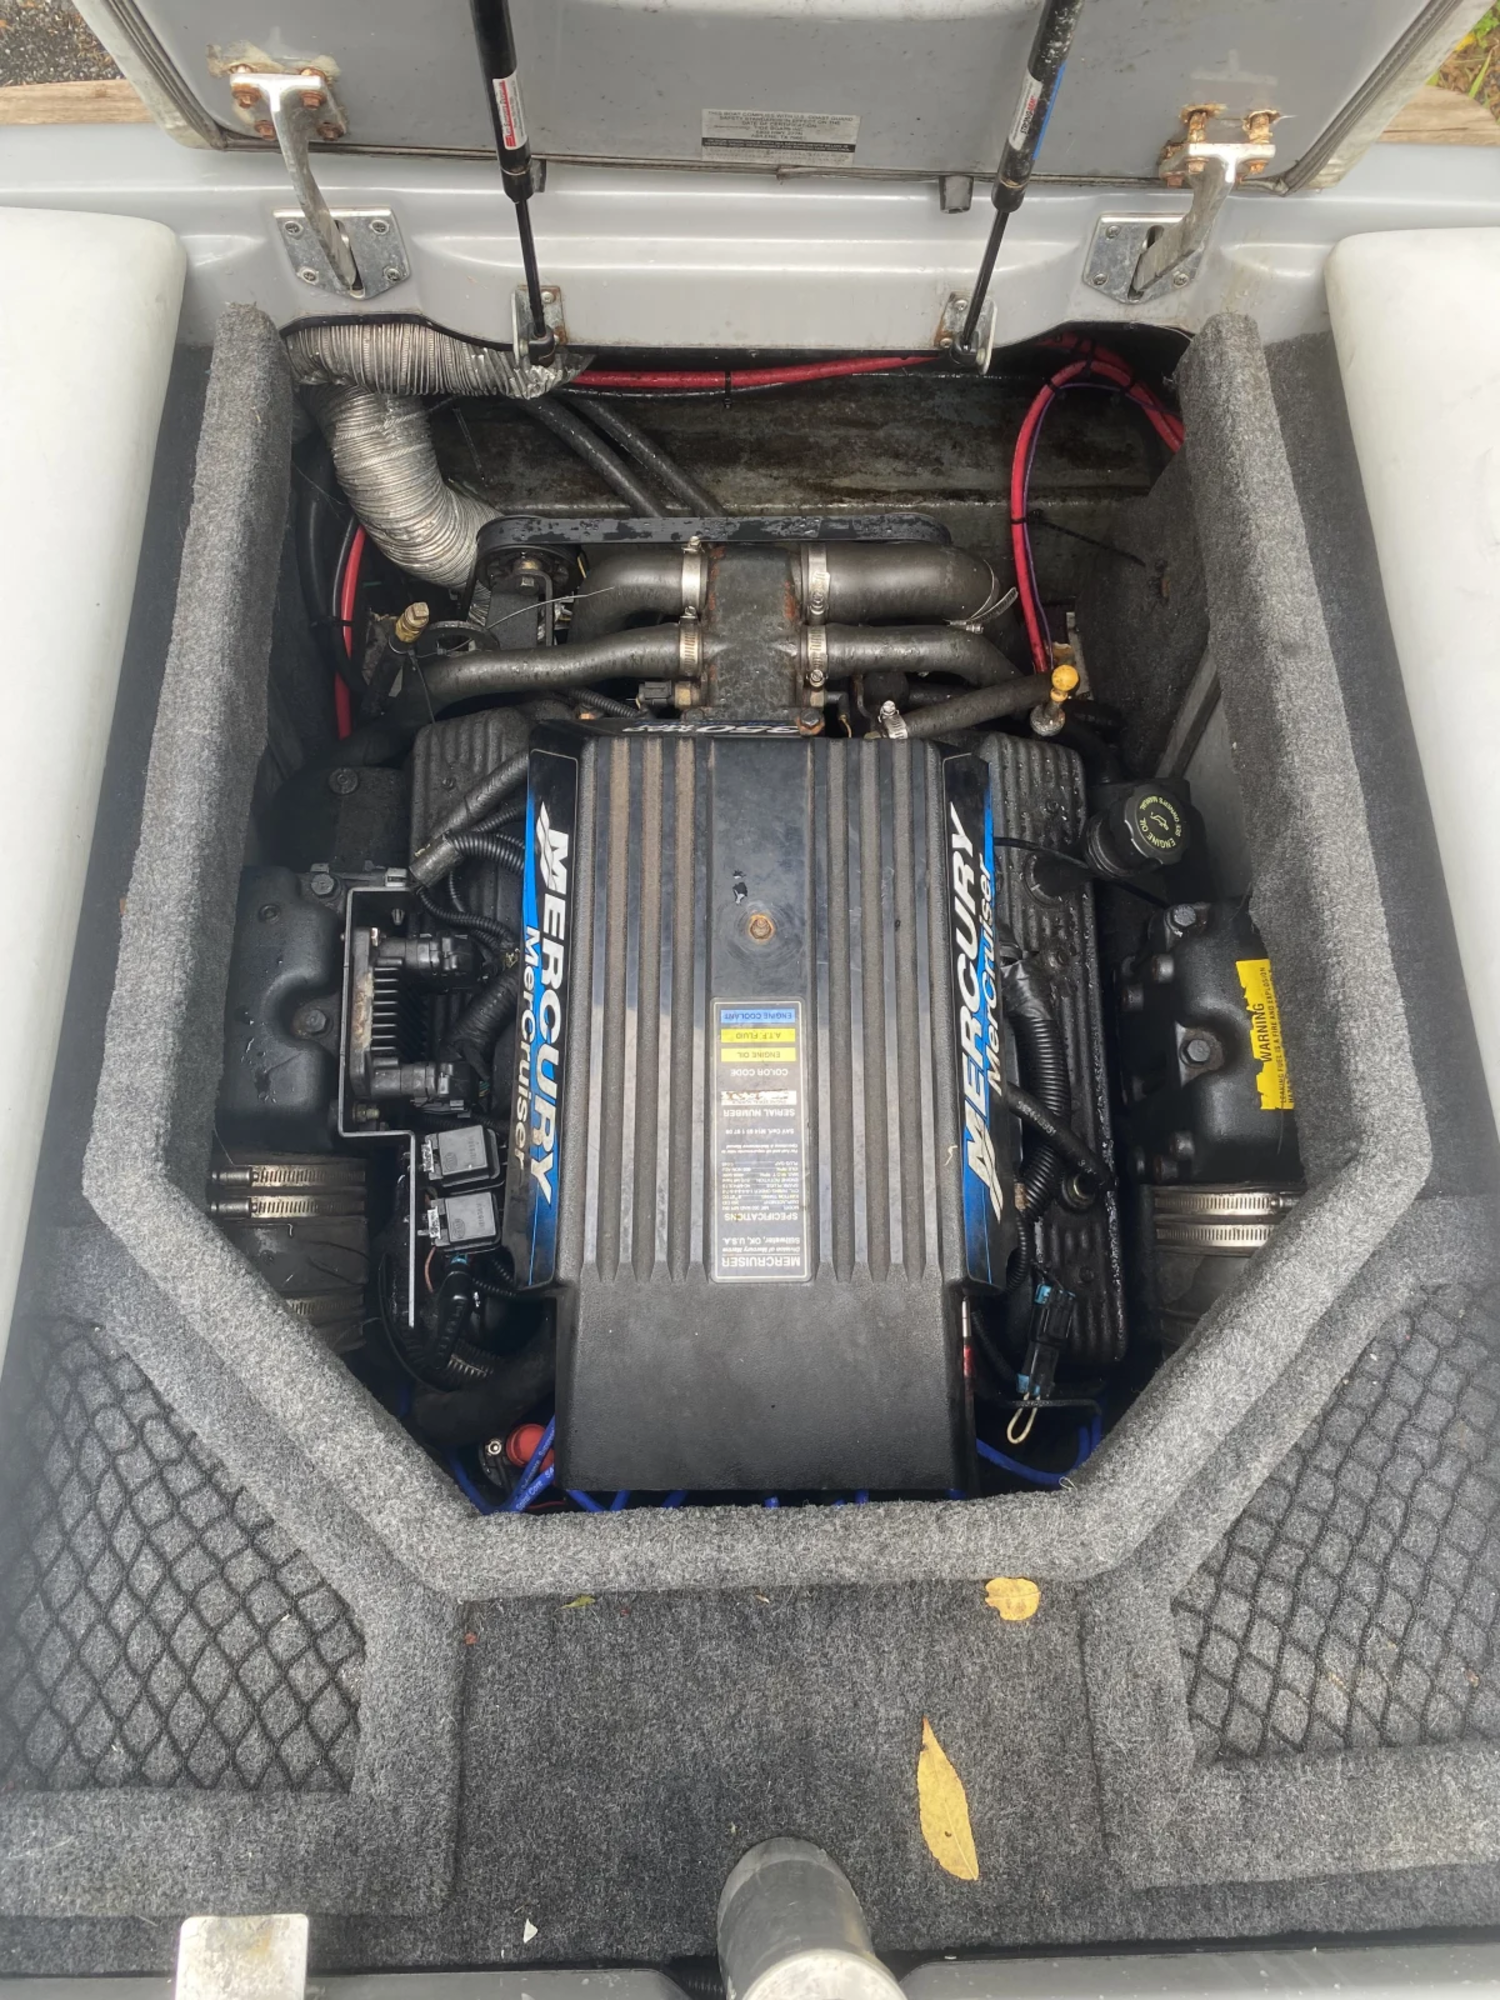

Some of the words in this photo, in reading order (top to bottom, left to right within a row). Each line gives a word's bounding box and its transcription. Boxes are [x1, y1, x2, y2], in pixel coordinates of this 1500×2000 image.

[695, 725, 799, 733] 350
[1139, 817, 1149, 832] OIL
[1146, 831, 1176, 848] ENGINE
[978, 852, 1003, 1097] MerCruiser
[1260, 967, 1274, 1004] EXPLOSION
[530, 802, 568, 1205] MERCURY
[724, 1012, 762, 1020] COOLANT
[763, 1012, 792, 1020] ENGINE
[950, 802, 1003, 1221] MERCURY
[1268, 1005, 1276, 1021] AND
[1253, 1003, 1272, 1062] WARNING
[1270, 1022, 1279, 1039] FIRE
[513, 925, 540, 1170] MerCruiser
[1275, 1055, 1284, 1073] FUEL
[730, 1068, 756, 1077] CODE
[757, 1068, 789, 1076] COLOR
[723, 1109, 762, 1117] NUMBER
[763, 1108, 796, 1117] SERIAL
[724, 1212, 798, 1221] SPECIFICATIONS
[722, 1237, 746, 1245] U.S.A.
[747, 1236, 762, 1244] OK,
[721, 1256, 801, 1267] MERCRUISER
[528, 1480, 543, 1495] Core
